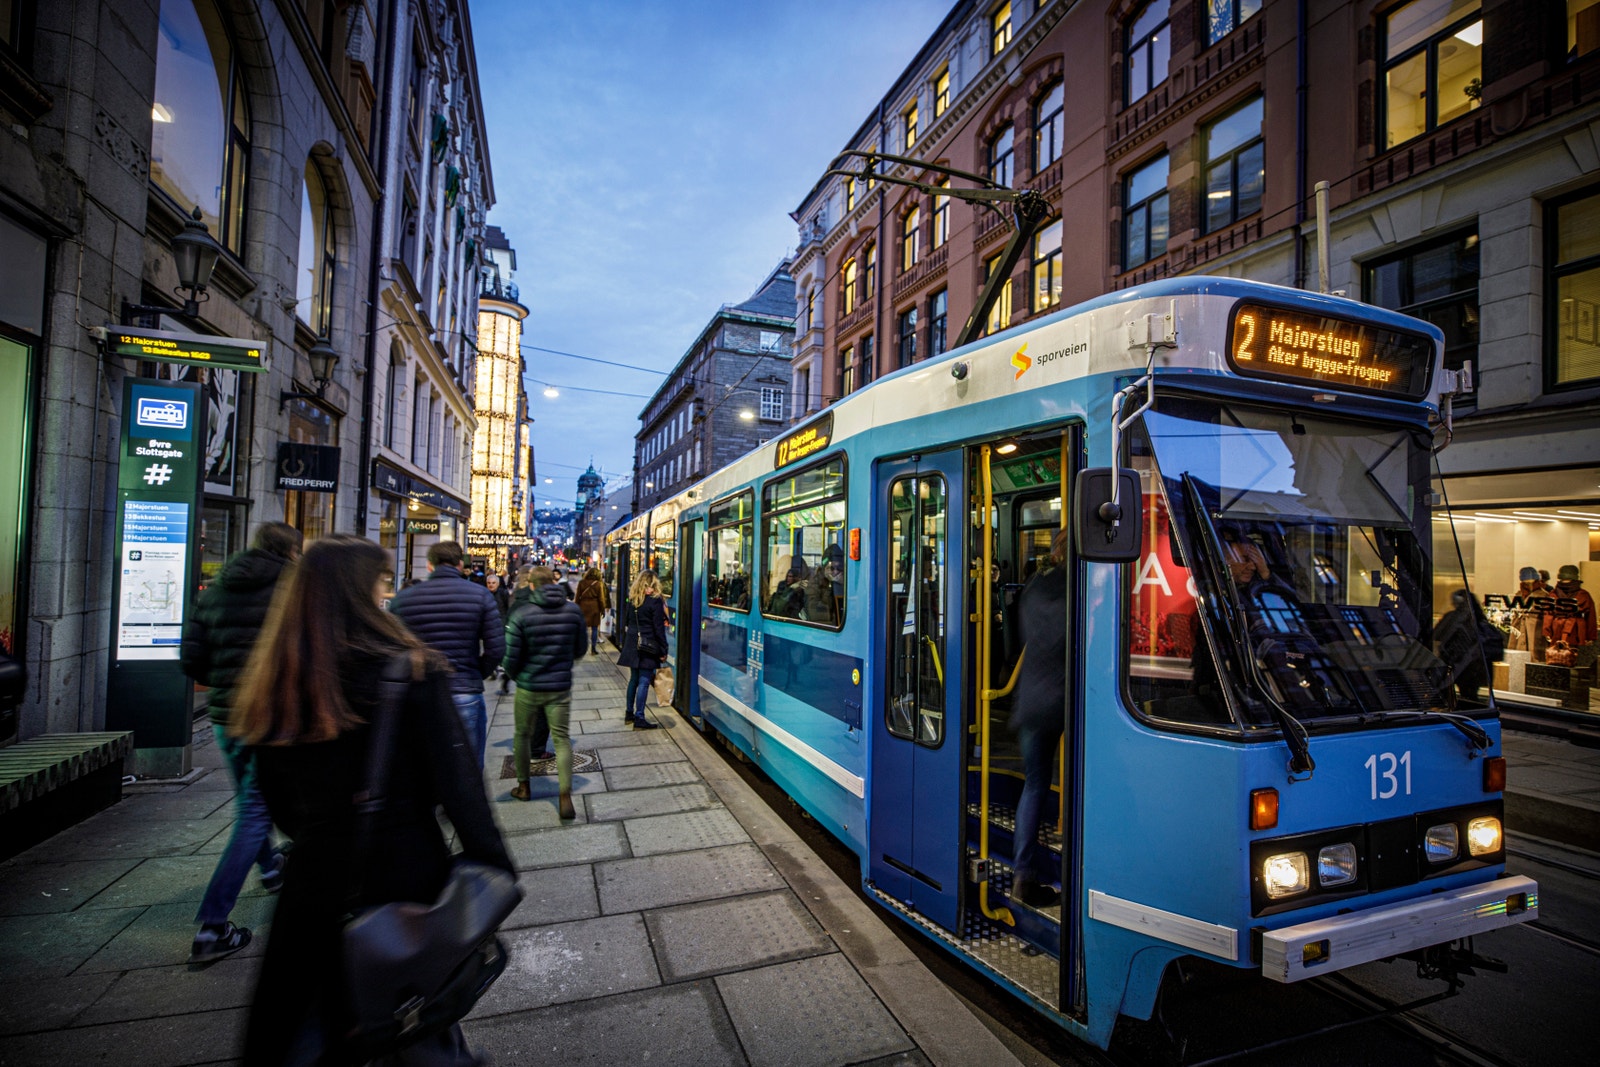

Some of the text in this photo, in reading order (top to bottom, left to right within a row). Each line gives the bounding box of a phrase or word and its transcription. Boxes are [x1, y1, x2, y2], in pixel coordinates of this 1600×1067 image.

[120, 336, 131, 344] 12
[132, 337, 177, 348] Majorstuen
[1236, 314, 1361, 361] 2 Majorstuen
[1037, 342, 1088, 367] sporveien
[1267, 345, 1392, 382] Aker brygge-Frogner
[135, 447, 184, 458] Slottsgate
[148, 439, 172, 449] Øvre
[778, 441, 789, 467] 12
[279, 477, 335, 488] FRED PERRY
[1484, 594, 1578, 613] FWSS
[1364, 751, 1412, 800] 131
